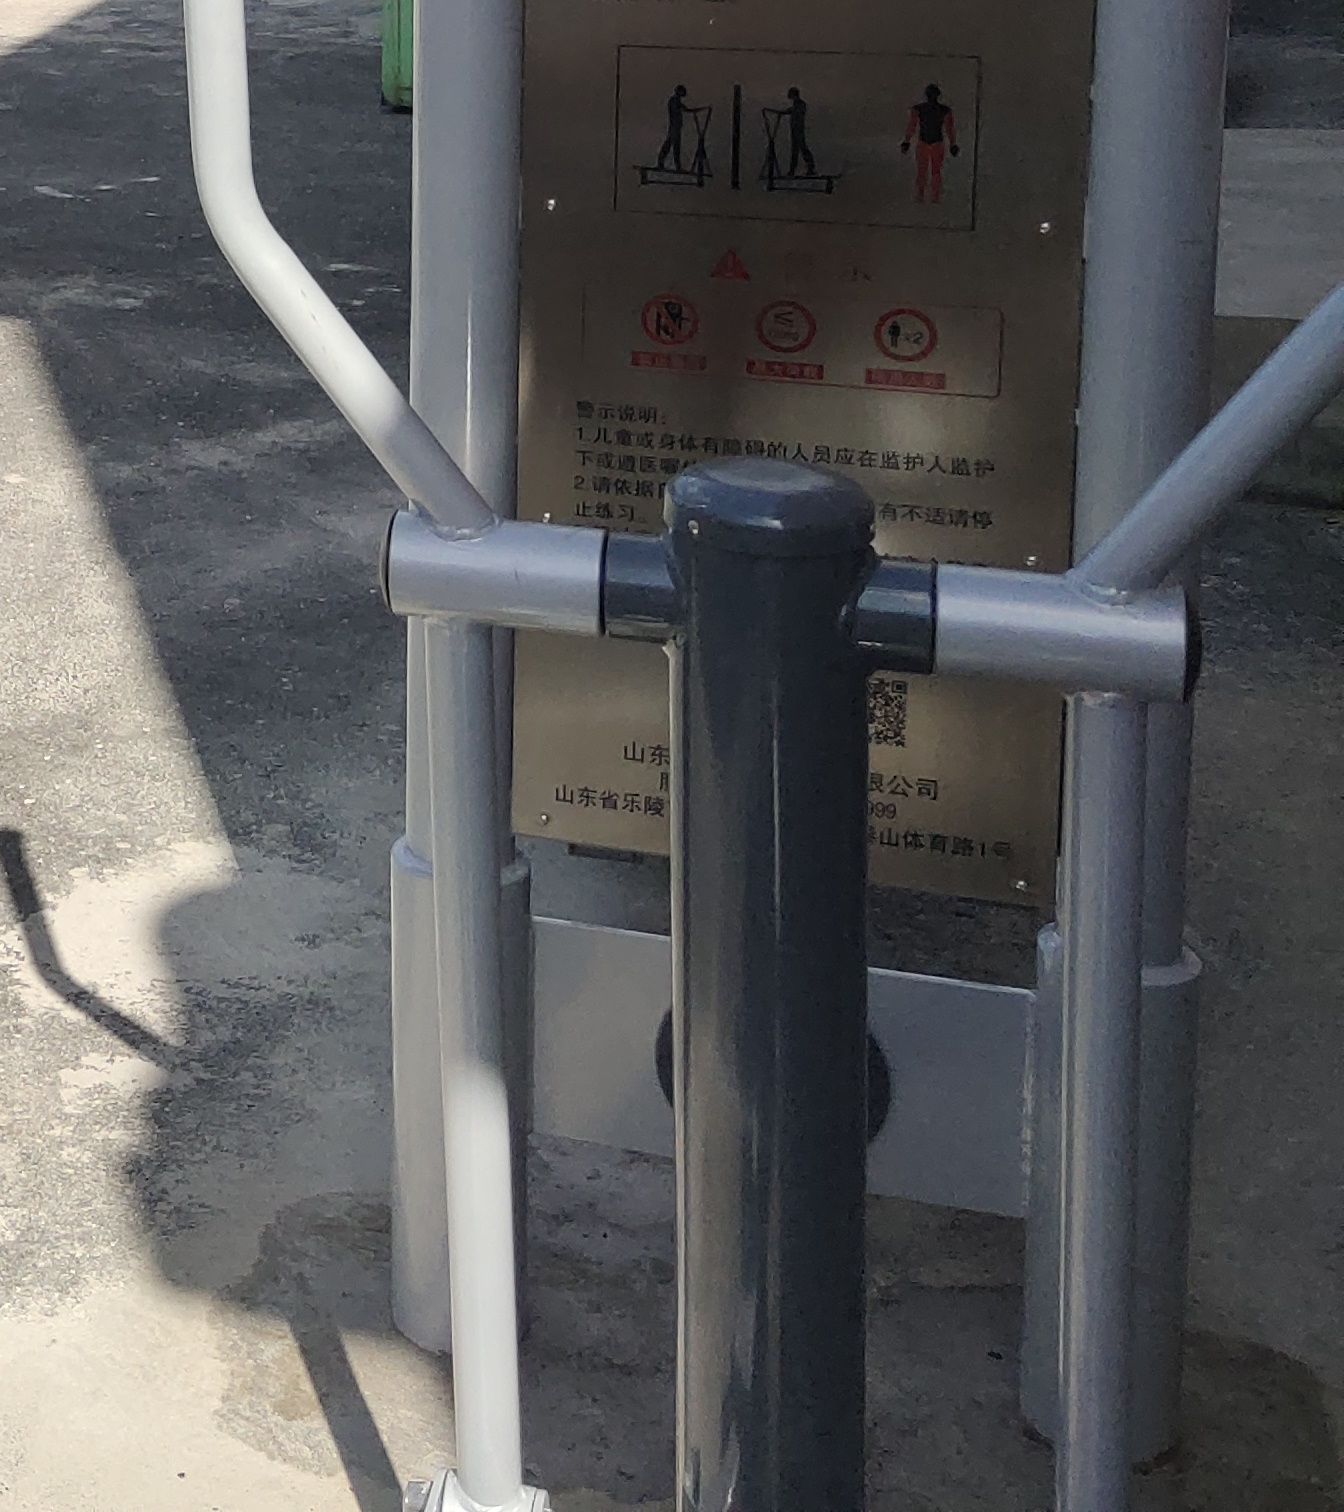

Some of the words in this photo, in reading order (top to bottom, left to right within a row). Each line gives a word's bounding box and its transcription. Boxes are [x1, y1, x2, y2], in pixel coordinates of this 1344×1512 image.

[554, 783, 666, 818] 山东省乐陵
